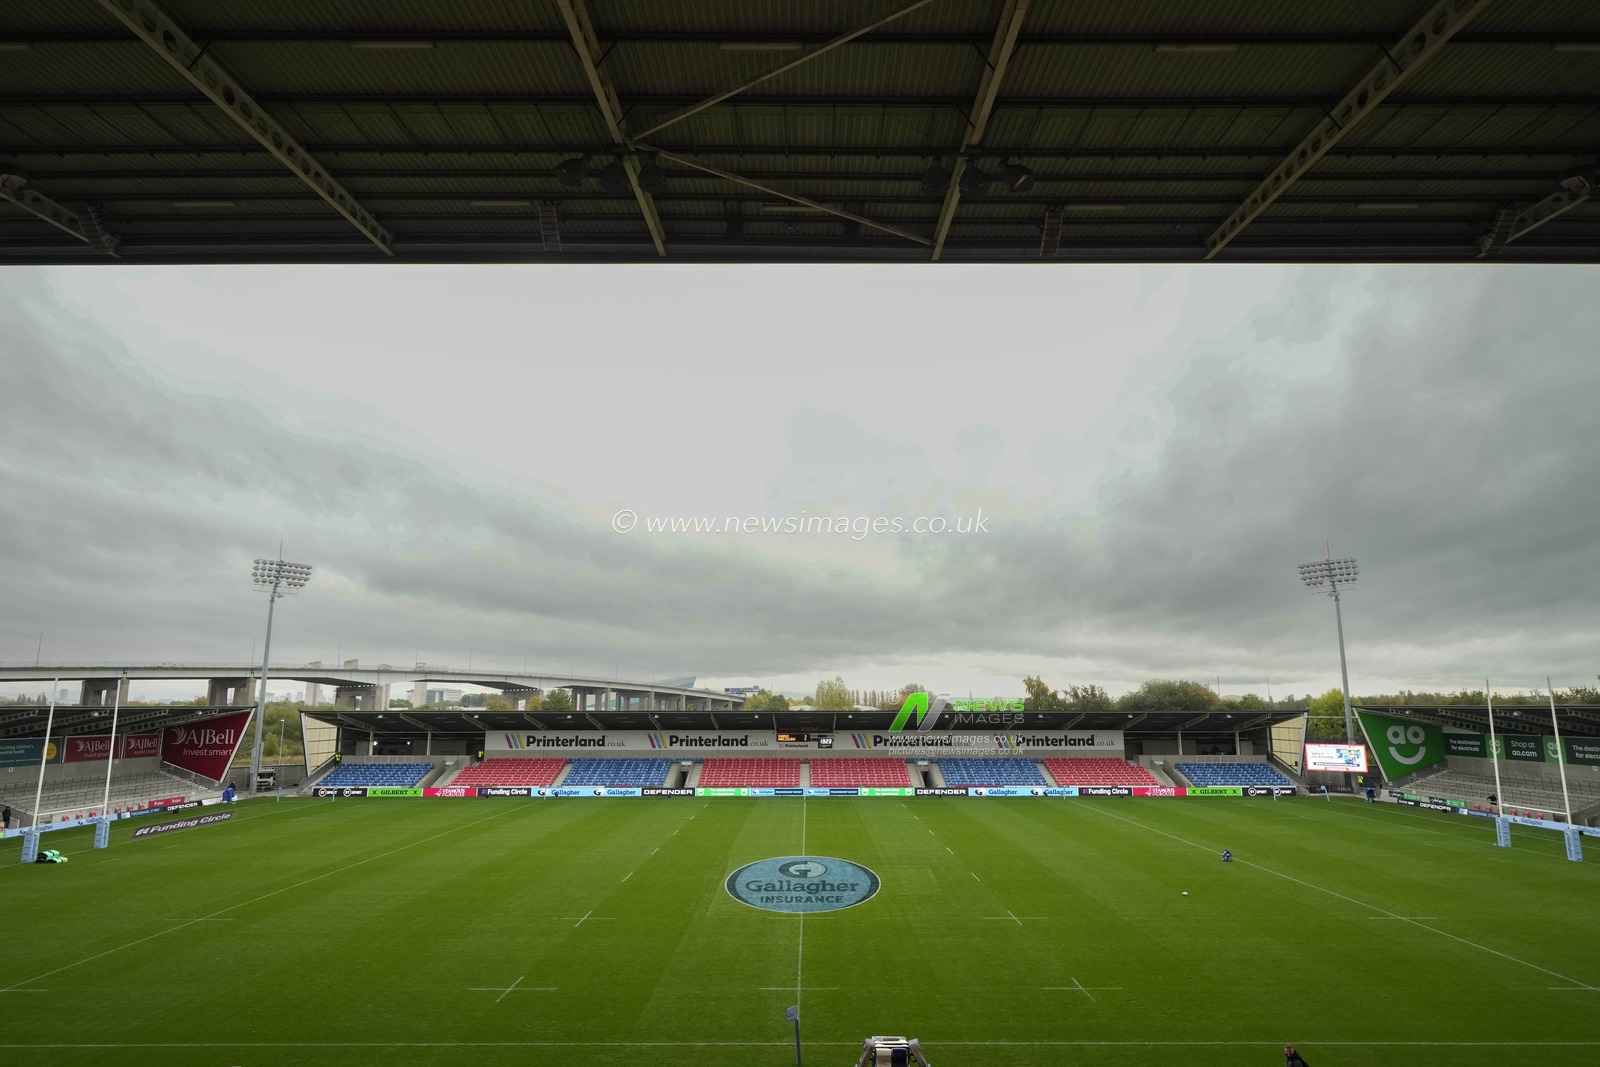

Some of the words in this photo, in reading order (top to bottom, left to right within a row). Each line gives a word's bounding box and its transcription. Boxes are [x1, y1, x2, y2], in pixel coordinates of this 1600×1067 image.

[1386, 725, 1425, 745] ao
[1511, 740, 1527, 748] Shop
[1528, 741, 1536, 749] at
[183, 748, 207, 756] Invest
[208, 748, 232, 756] smart
[1088, 788, 1111, 796] Funding
[167, 802, 198, 811] DEFENDER
[149, 820, 199, 833] Funding
[200, 813, 231, 824] Circle
[1520, 817, 1543, 826] Gallagher
[745, 879, 859, 895] Gallagher
[760, 895, 844, 904] INSURANCE
